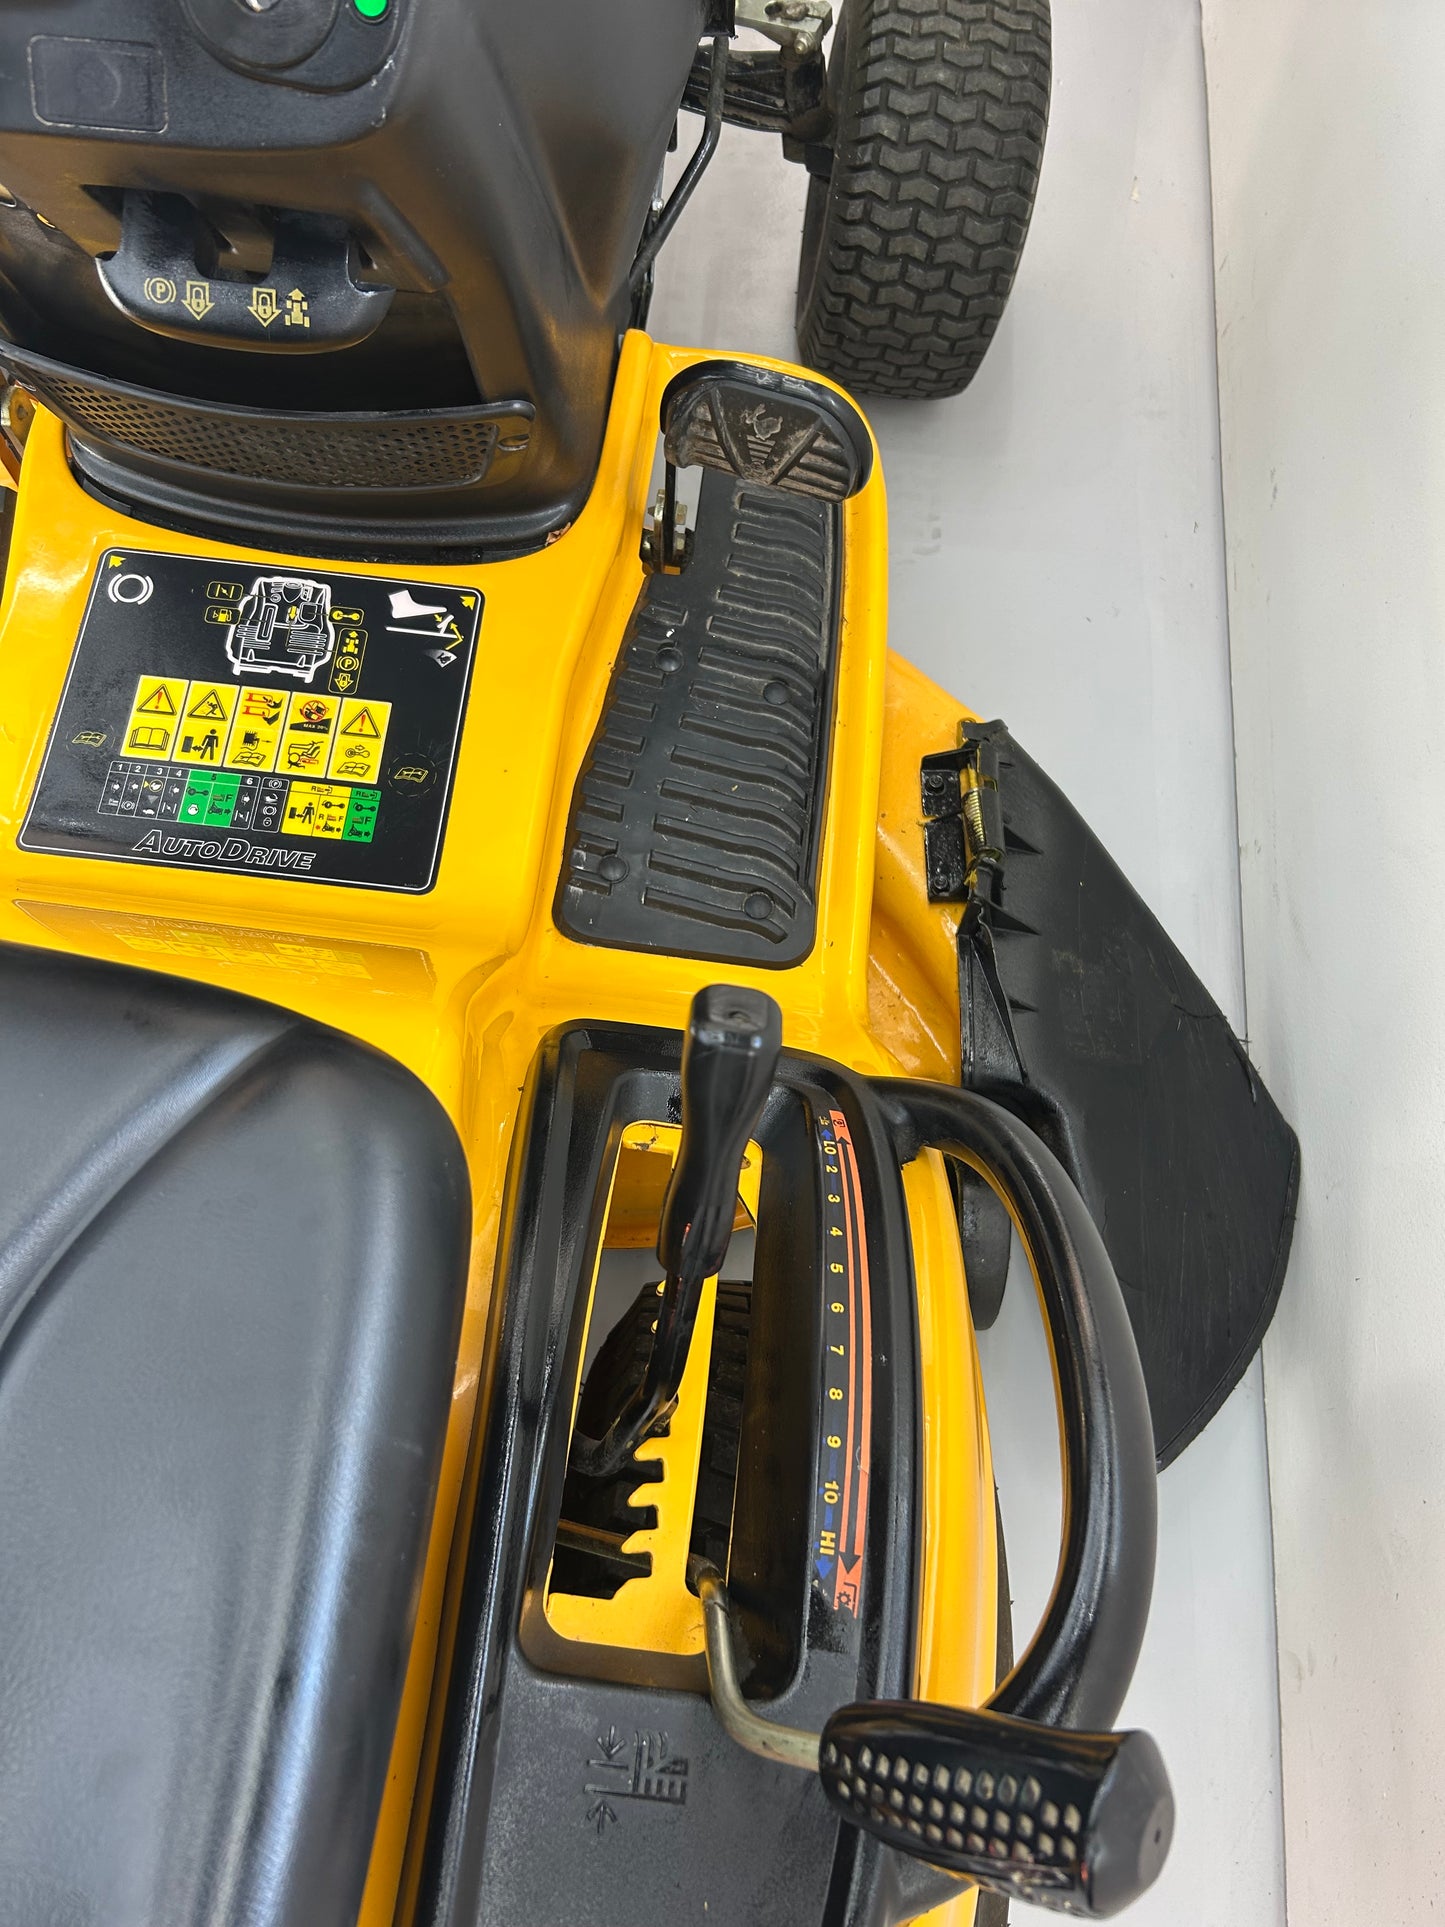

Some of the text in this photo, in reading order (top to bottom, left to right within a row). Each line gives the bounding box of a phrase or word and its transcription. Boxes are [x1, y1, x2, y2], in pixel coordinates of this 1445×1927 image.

[156, 283, 166, 299] P
[117, 763, 254, 785] 1 2 3 4 5 6
[225, 794, 233, 802] F
[364, 816, 372, 824] F
[826, 1165, 838, 1174] 2
[828, 1194, 841, 1203] 3
[830, 1226, 843, 1237] 4
[830, 1262, 844, 1273] 5
[831, 1302, 845, 1313] 6
[830, 1344, 845, 1356] 7
[829, 1387, 843, 1400] 8
[826, 1435, 842, 1448] 9
[823, 1480, 840, 1505] 10
[819, 1530, 837, 1556] HI
